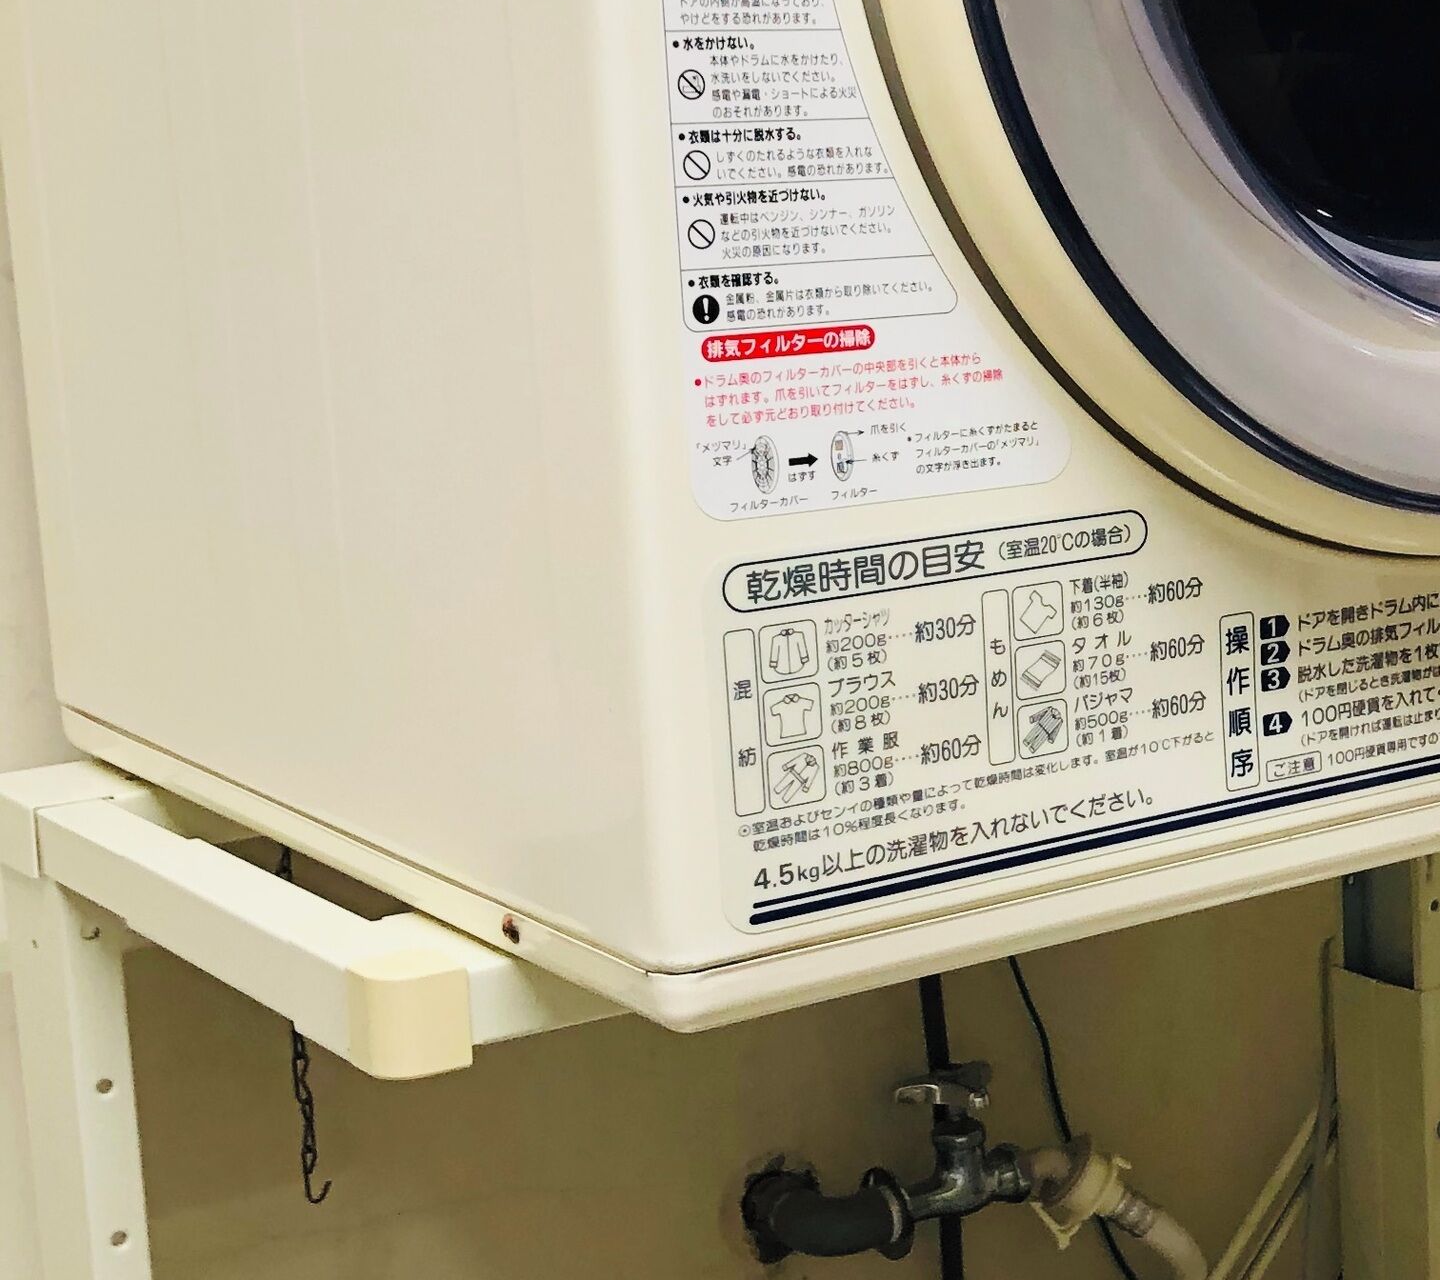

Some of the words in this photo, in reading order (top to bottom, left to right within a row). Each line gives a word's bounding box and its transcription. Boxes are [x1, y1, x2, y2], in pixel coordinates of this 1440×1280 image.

[683, 36, 755, 51] 水をかけない。
[688, 127, 801, 144] 衣類は十分に脱水する。
[693, 188, 826, 207] 火気や引火物を近づけない。
[698, 272, 779, 290] 衣類を確認する。
[707, 327, 872, 360] 排気フィルターの掃除
[870, 421, 907, 435] 爪を引く
[712, 455, 732, 467] 文字
[871, 451, 900, 463] 糸くず
[787, 470, 816, 483] はずす
[831, 485, 878, 501] フィルター
[730, 494, 809, 514] フィルターカバー
[746, 540, 986, 604] 乾燥時間の目安
[824, 608, 891, 636] カッターシャツ
[827, 671, 896, 699] ブラウス
[1074, 687, 1133, 713] パジャマ
[1226, 625, 1255, 778] 操作順序
[1273, 756, 1316, 778] ご注意
